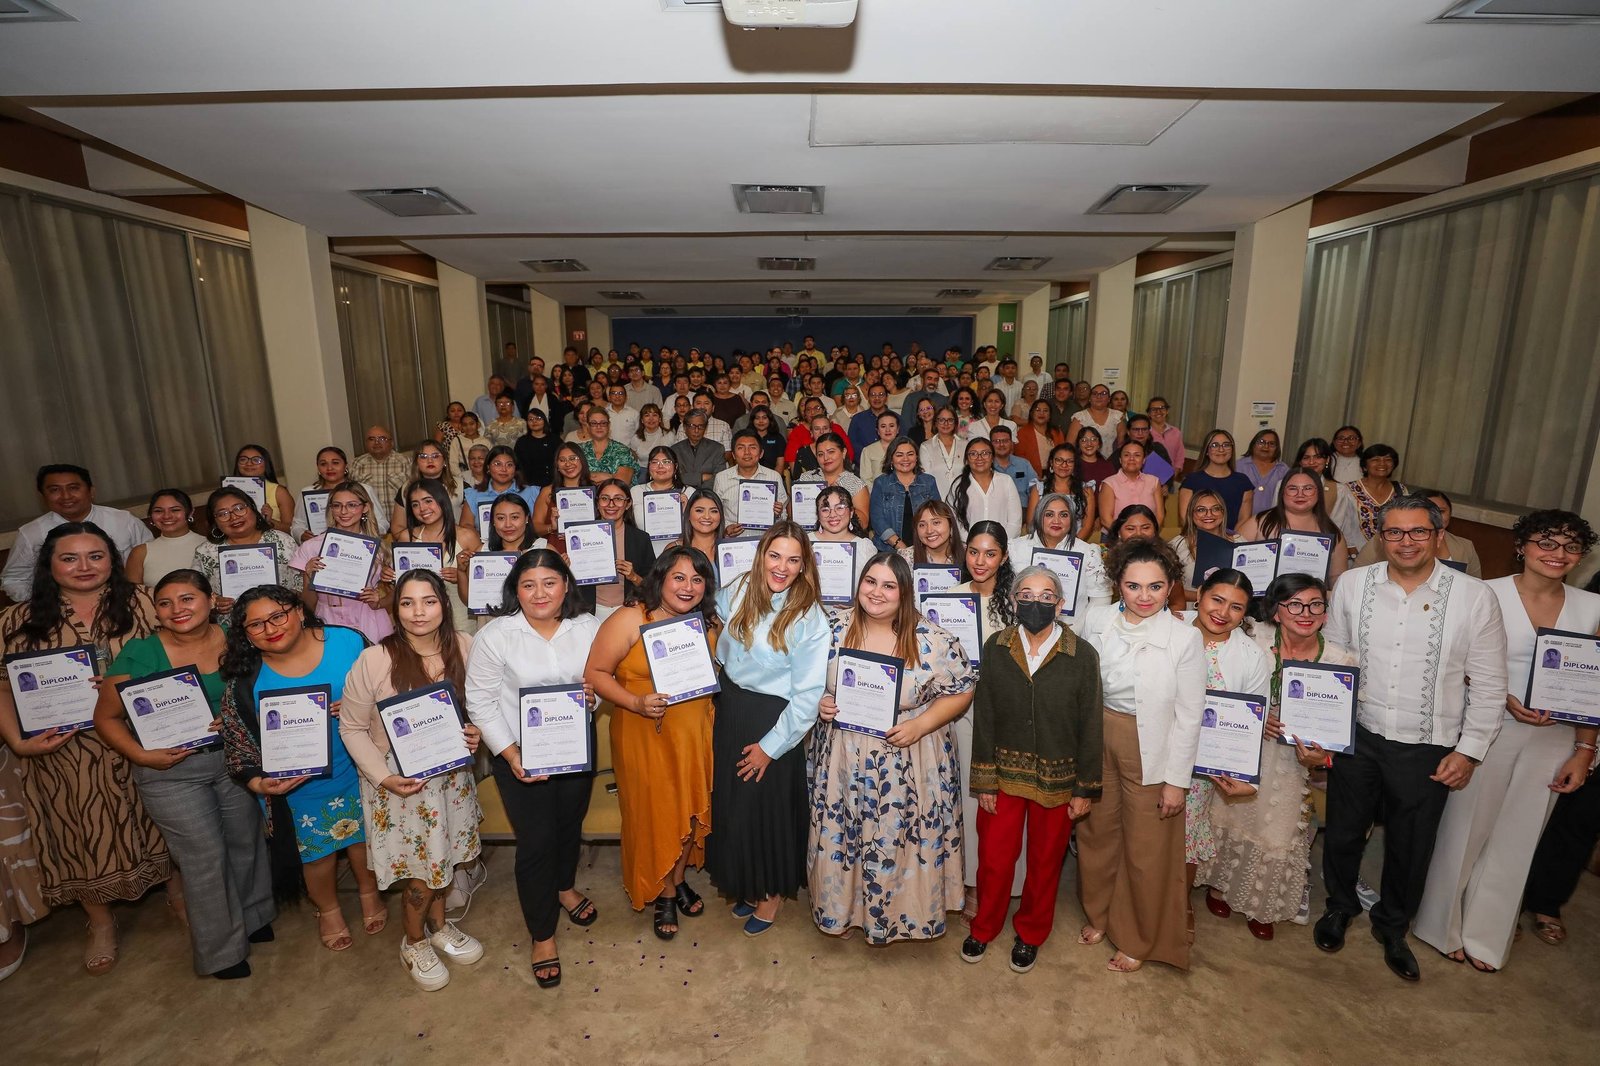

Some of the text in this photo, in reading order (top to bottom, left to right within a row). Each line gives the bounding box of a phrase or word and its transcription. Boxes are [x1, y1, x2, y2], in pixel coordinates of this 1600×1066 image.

[341, 552, 362, 560] DIPLOMA
[669, 642, 696, 653] DIPLOMA
[1564, 662, 1600, 671] DIPLOMA
[40, 674, 79, 686] DIPLOMA
[858, 681, 884, 690] DIPLOMA
[1306, 692, 1338, 700] DIPLOMA
[156, 696, 190, 708] DIPLOMA
[284, 718, 314, 726] DIPLOMA
[412, 714, 444, 728] DIPLOMA
[1219, 721, 1249, 730] DIPLOMA
